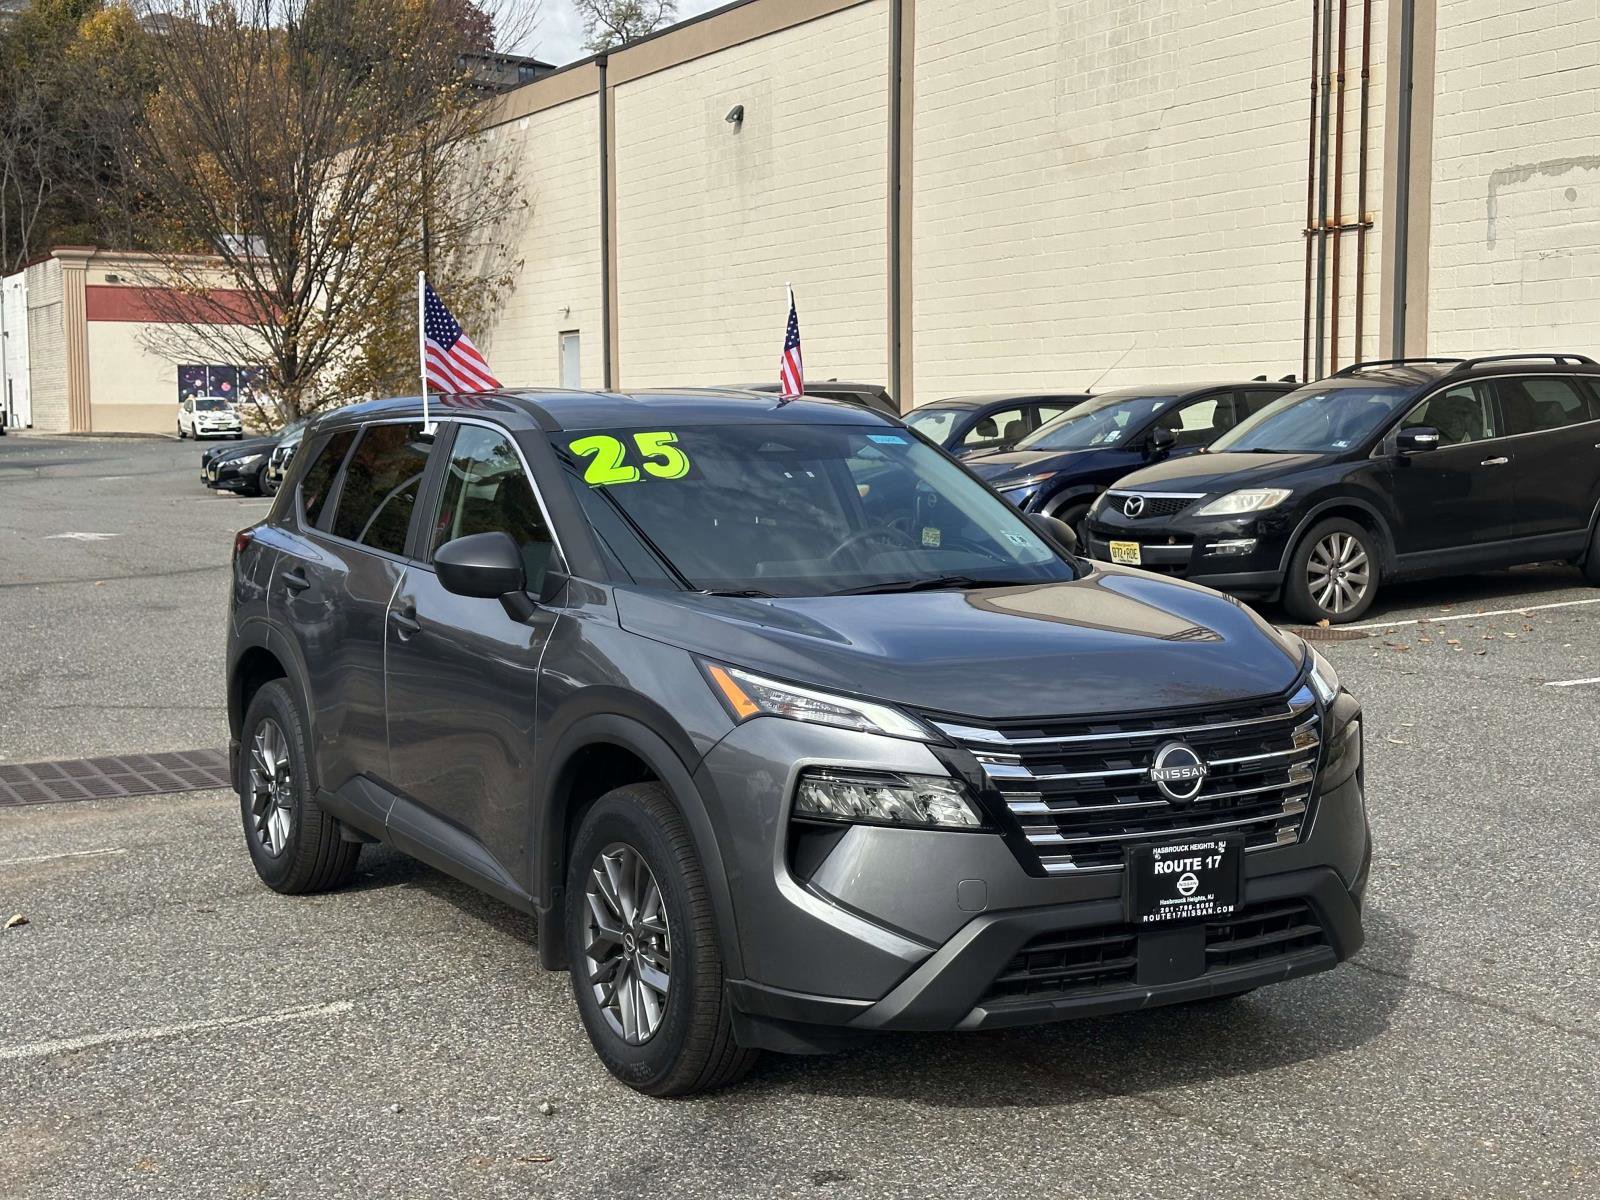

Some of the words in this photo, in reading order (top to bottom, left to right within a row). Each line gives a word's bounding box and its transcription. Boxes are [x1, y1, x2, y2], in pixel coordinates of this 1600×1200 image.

[569, 431, 690, 486] 25
[1153, 765, 1207, 780] NISSAN
[1153, 845, 1189, 855] HASBROUCK
[1155, 858, 1202, 874] ROUTE
[1206, 855, 1221, 869] 17
[1143, 905, 1234, 922] ROUTE17NISSAN.COM
